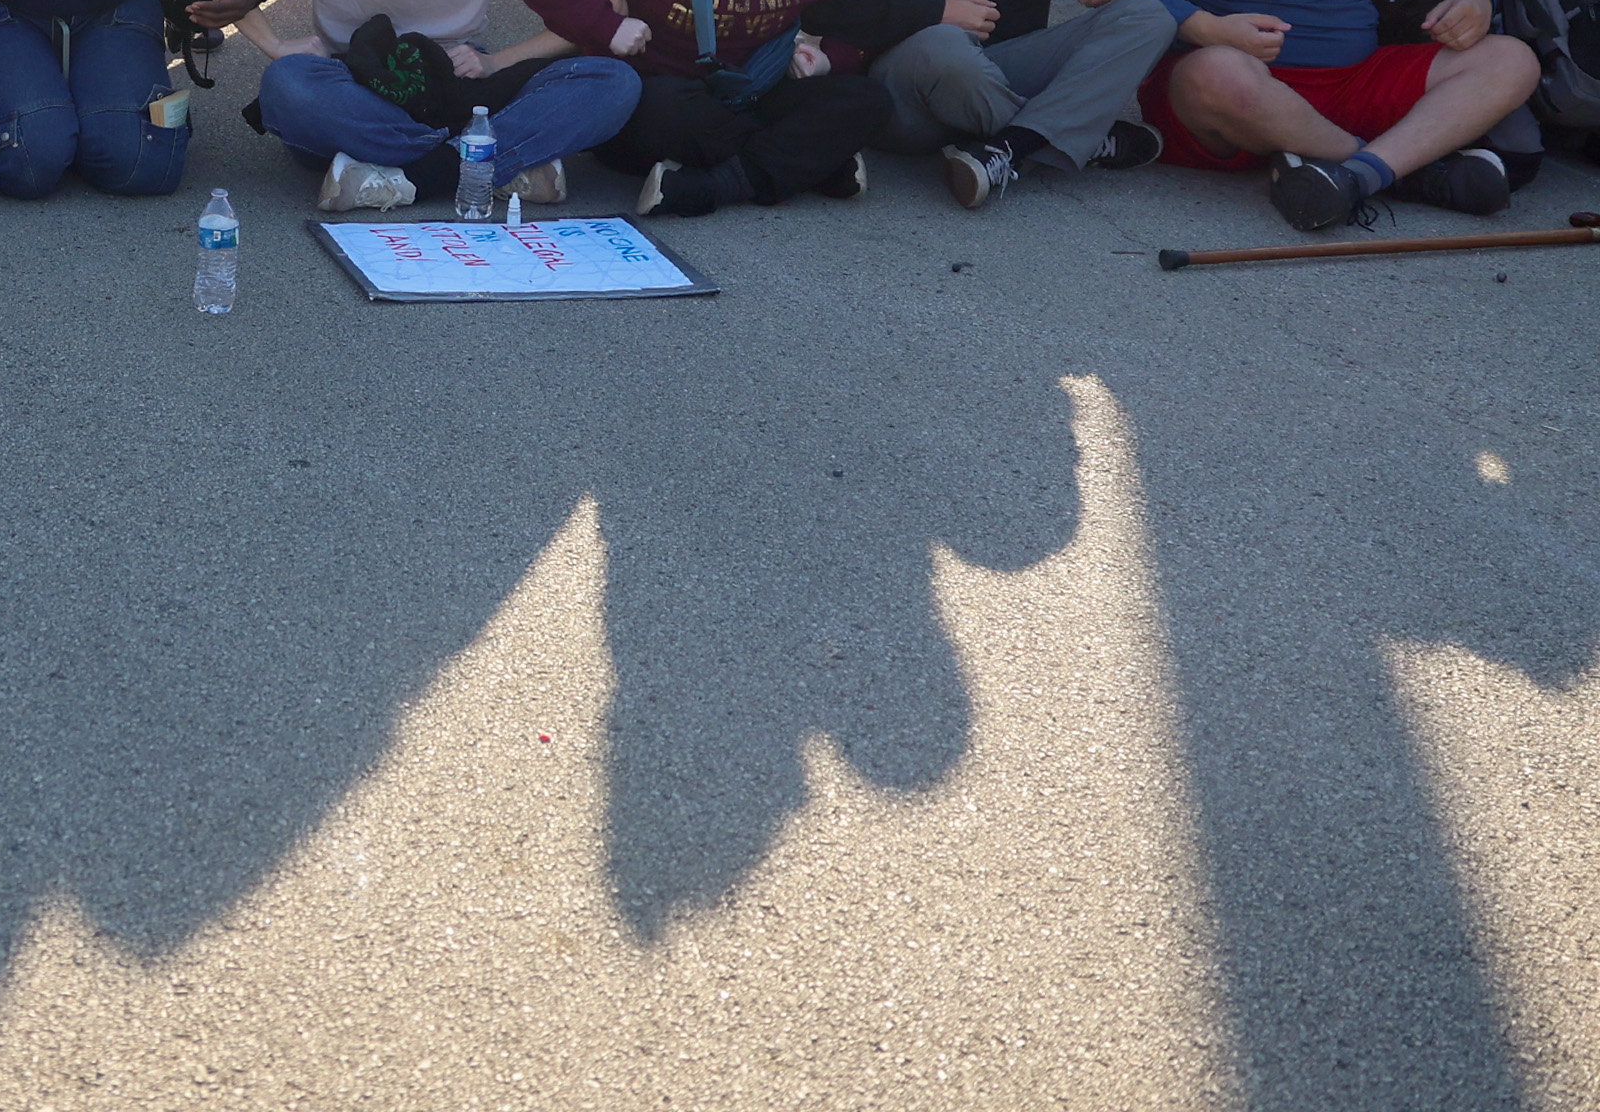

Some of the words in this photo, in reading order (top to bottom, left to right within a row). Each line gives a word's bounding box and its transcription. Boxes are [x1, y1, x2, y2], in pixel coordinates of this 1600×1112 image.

[369, 228, 438, 261] LAND!
[421, 225, 491, 266] STOLEN
[501, 223, 574, 271] ILLEGAL
[553, 226, 585, 237] IS
[585, 221, 620, 236] NO
[608, 237, 650, 262] ONE
